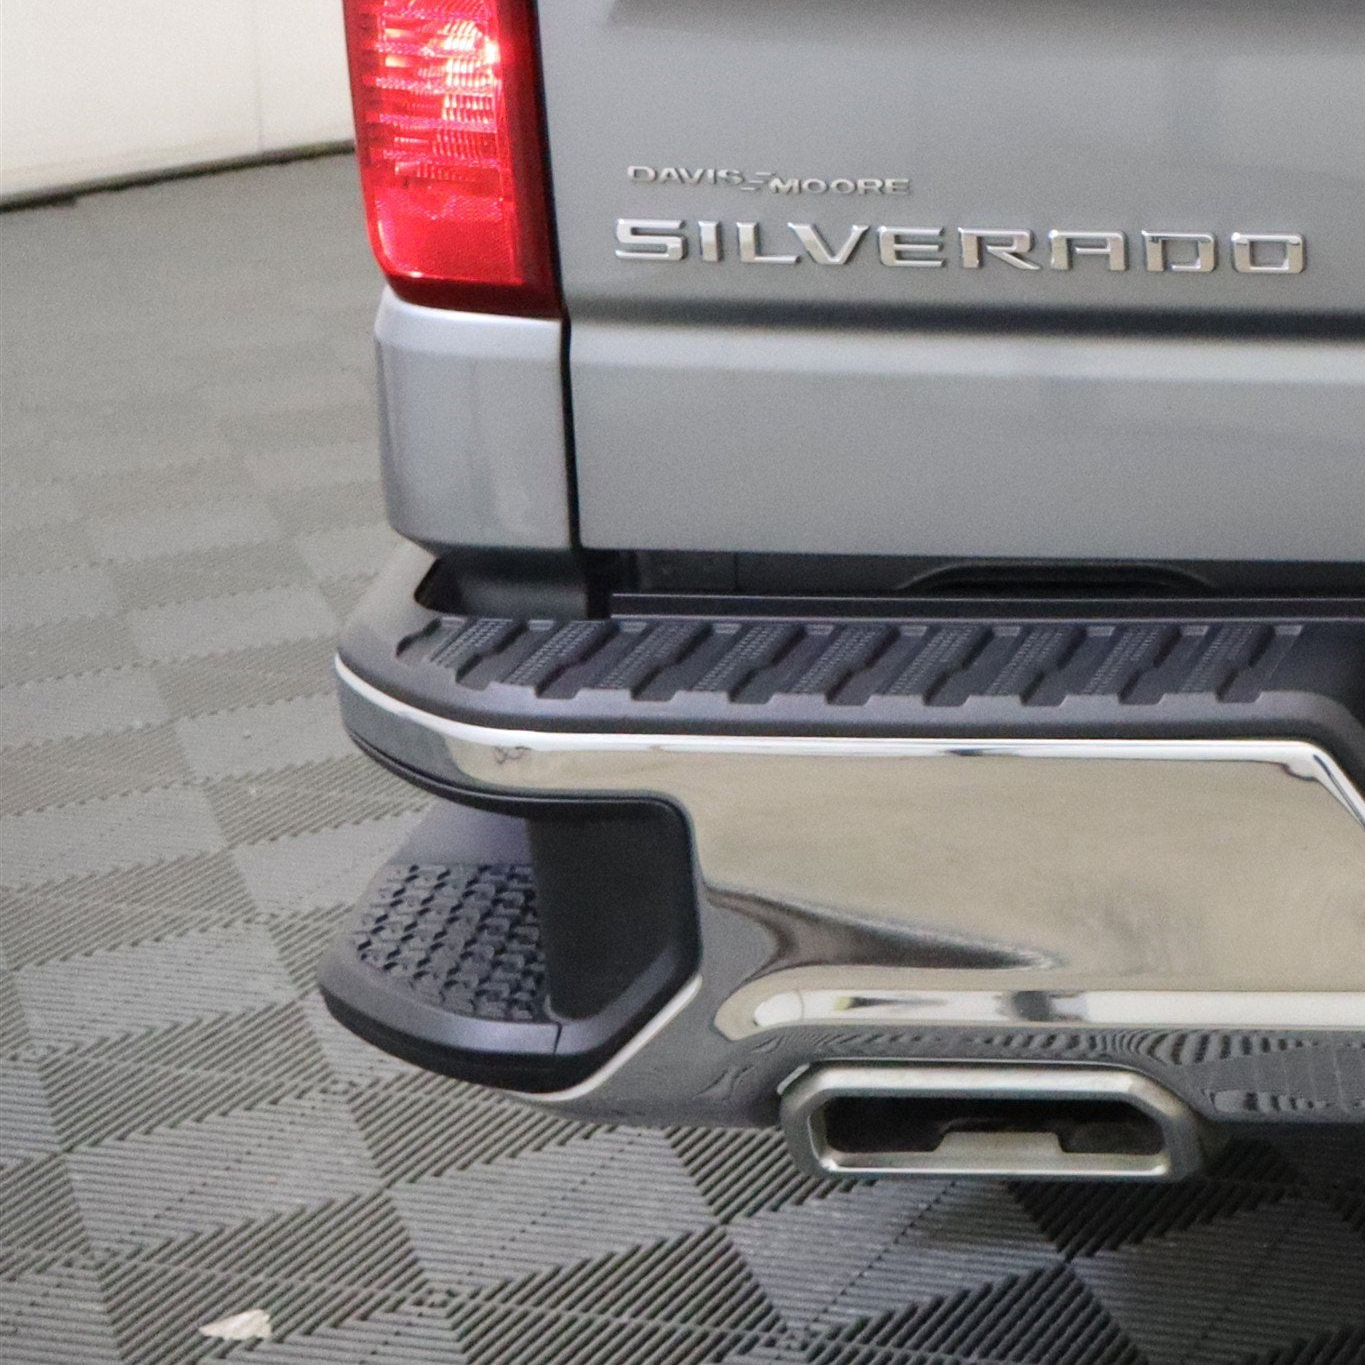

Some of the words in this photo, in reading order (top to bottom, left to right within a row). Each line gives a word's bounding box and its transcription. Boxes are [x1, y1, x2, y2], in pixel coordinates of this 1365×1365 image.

[627, 165, 745, 186] DAVIS
[768, 177, 910, 195] MOORE
[614, 218, 1305, 274] SILVERADO
